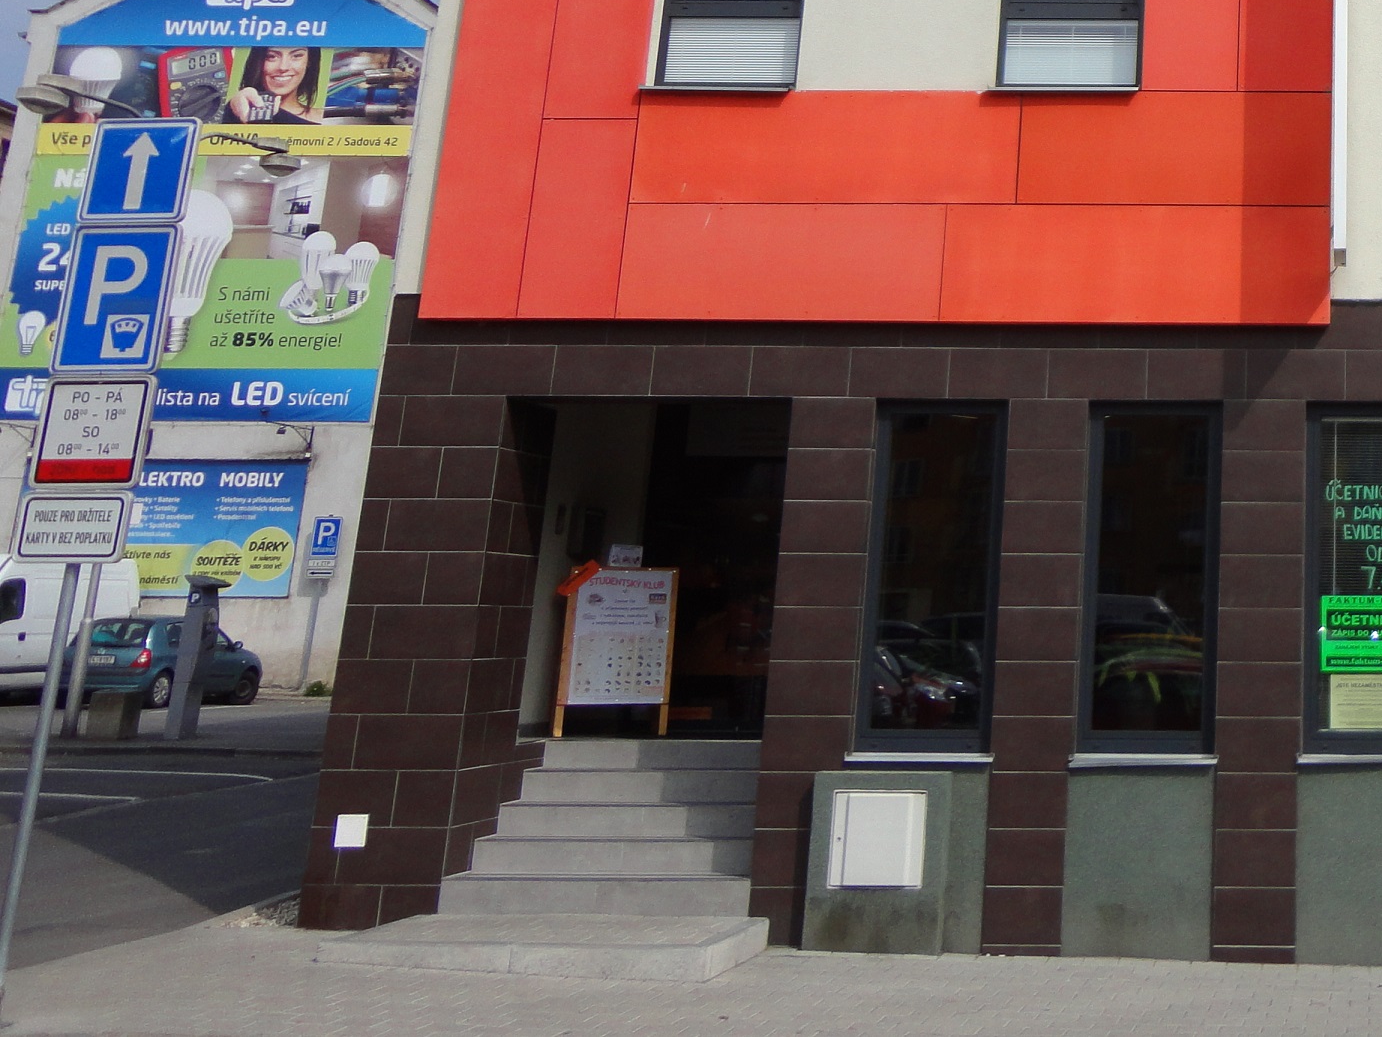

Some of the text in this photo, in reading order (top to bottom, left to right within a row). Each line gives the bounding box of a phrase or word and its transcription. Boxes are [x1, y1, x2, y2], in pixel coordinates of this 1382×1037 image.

[165, 17, 328, 41] www.tipa.eu
[52, 131, 79, 146] Vše
[288, 136, 324, 147] ěmovní
[327, 137, 334, 147] 2
[343, 136, 381, 147] Sadová
[384, 137, 398, 147] 42
[53, 167, 87, 188] Ná
[46, 223, 71, 235] LED
[34, 279, 66, 291] SUPE
[84, 245, 149, 325] P
[218, 286, 271, 301] S námi
[213, 309, 275, 324] ušetříte
[209, 332, 343, 351] až 85% energie!
[72, 391, 90, 404] PO
[105, 387, 124, 403] PÁ
[156, 381, 351, 406] lista na LED svícení
[82, 426, 100, 438] SO
[139, 471, 284, 488] LEKTRO MOBILY
[34, 508, 114, 522] POUZE PRO DRŽITELE
[1335, 506, 1345, 519] A
[25, 532, 113, 544] KARTY V BEZ POPLATKU
[317, 522, 336, 545] P
[249, 537, 290, 552] DÁRKY
[153, 550, 172, 559] nás
[195, 553, 242, 566] SOUTĚŽE
[139, 575, 180, 585] náměstí
[589, 576, 641, 588] STUDENTSKÝ
[643, 579, 666, 589] KLUB
[191, 593, 200, 603] P
[1331, 629, 1356, 637] ZÁPIS
